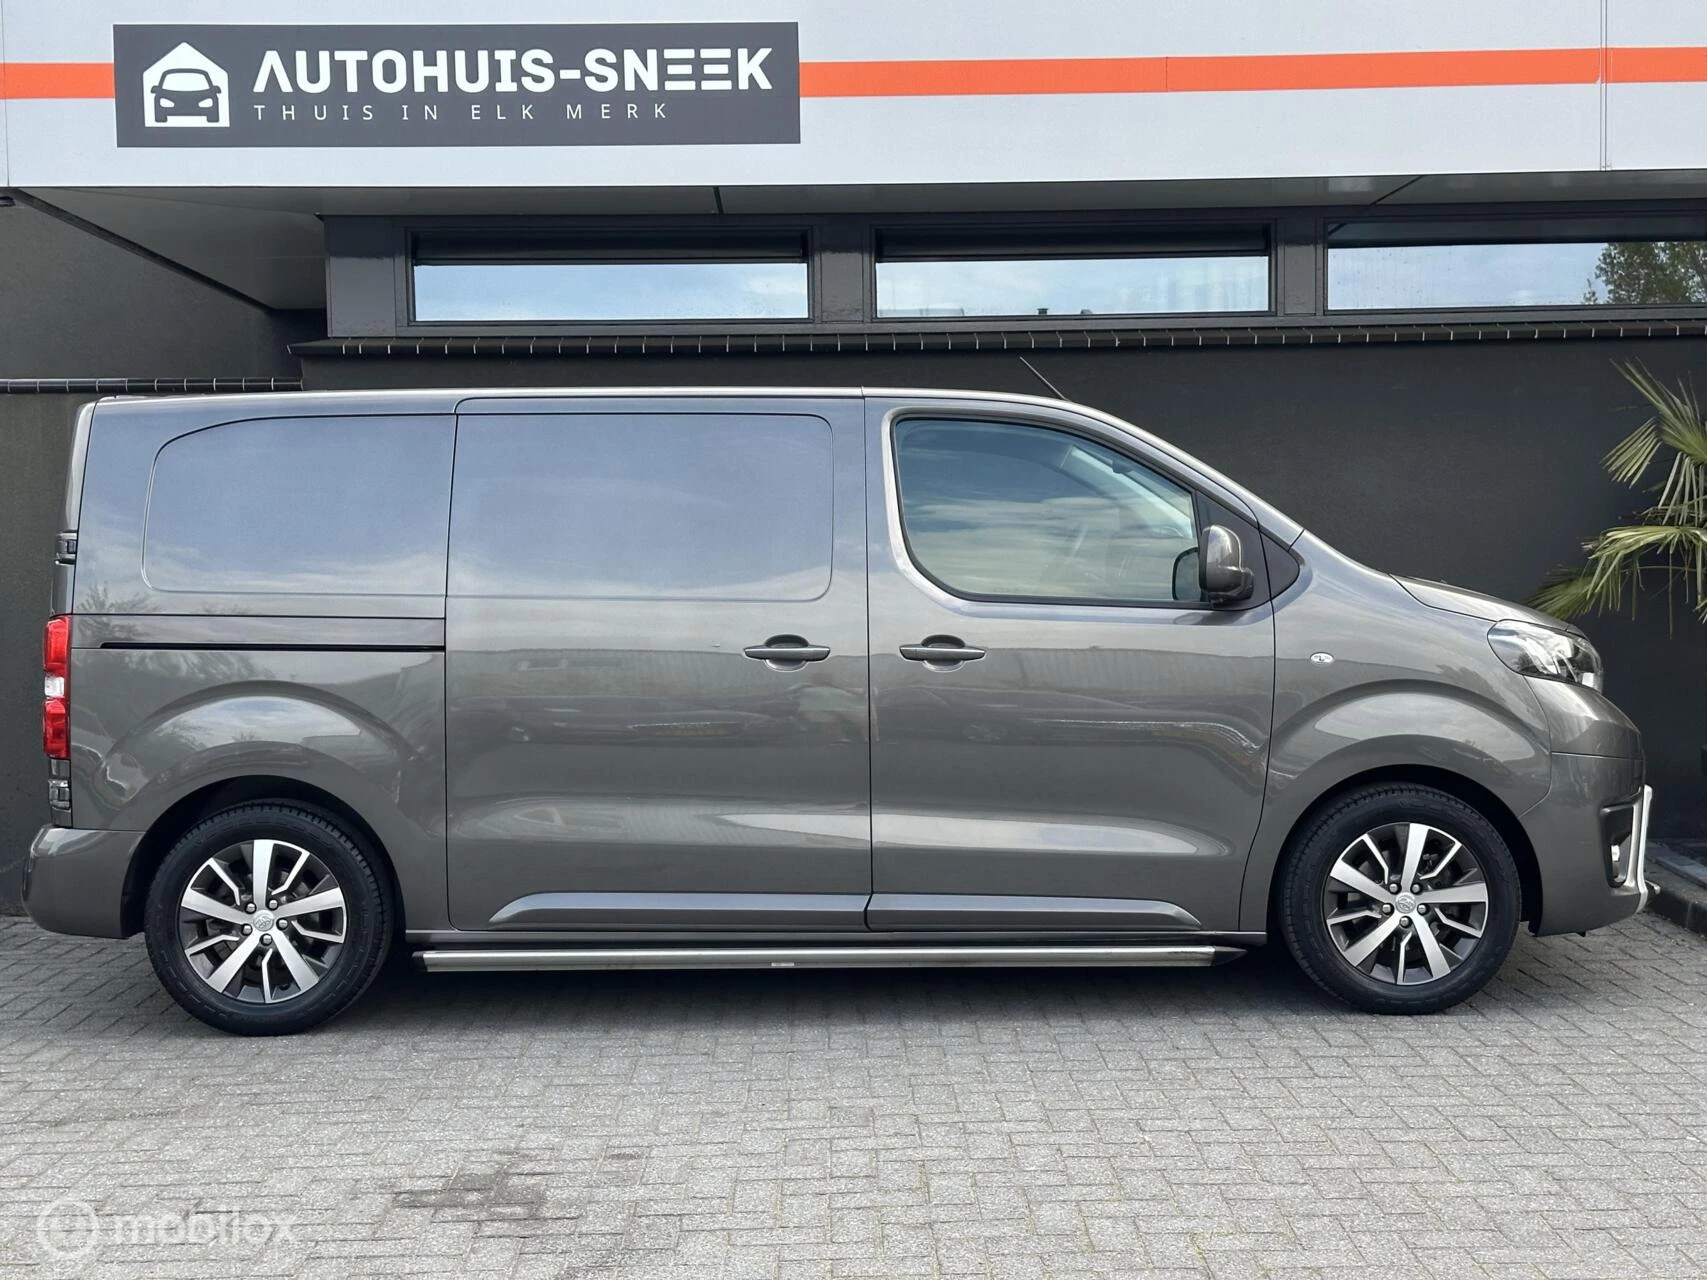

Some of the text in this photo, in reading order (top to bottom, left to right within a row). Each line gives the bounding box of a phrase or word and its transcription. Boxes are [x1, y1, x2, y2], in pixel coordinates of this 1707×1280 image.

[253, 47, 773, 94] AUTOHUIS-SNEEK
[253, 103, 666, 121] THUIS IN ELK MERK
